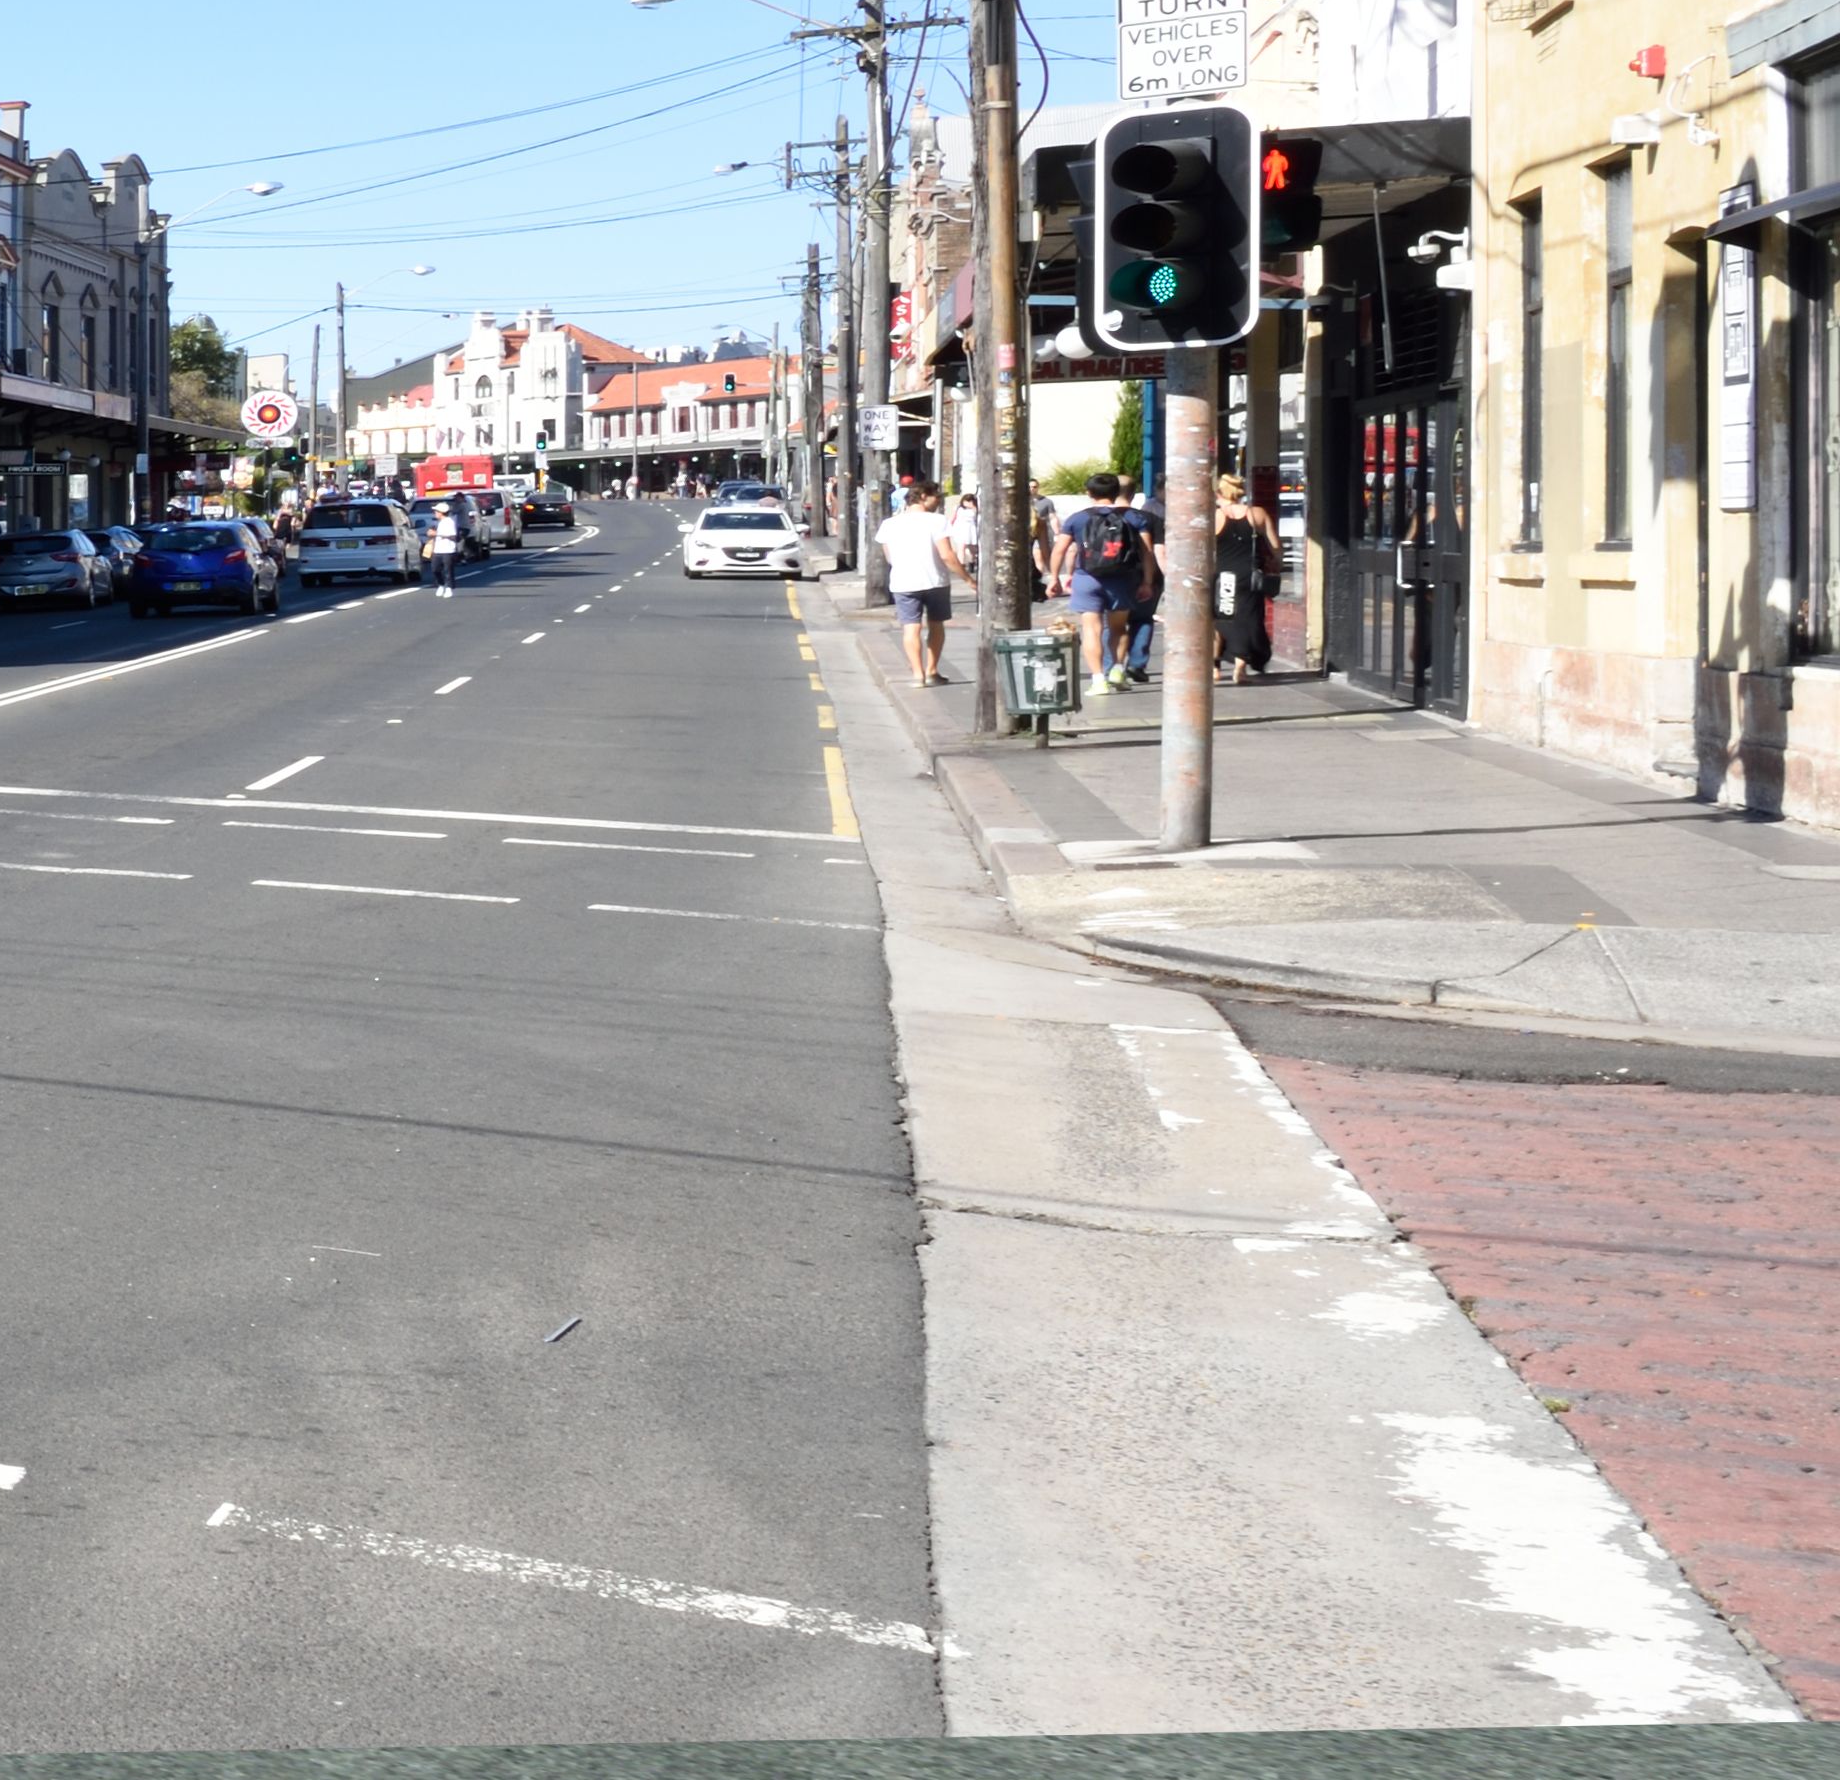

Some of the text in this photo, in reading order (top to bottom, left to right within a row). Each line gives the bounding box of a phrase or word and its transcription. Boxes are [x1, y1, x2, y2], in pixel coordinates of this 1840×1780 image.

[1128, 17, 1239, 46] VEHICLES
[1152, 45, 1212, 67] OVER
[1128, 65, 1240, 93] 6m LONG
[1069, 356, 1166, 378] PRACTICE
[864, 410, 889, 421] ONE
[864, 423, 889, 433] WAY
